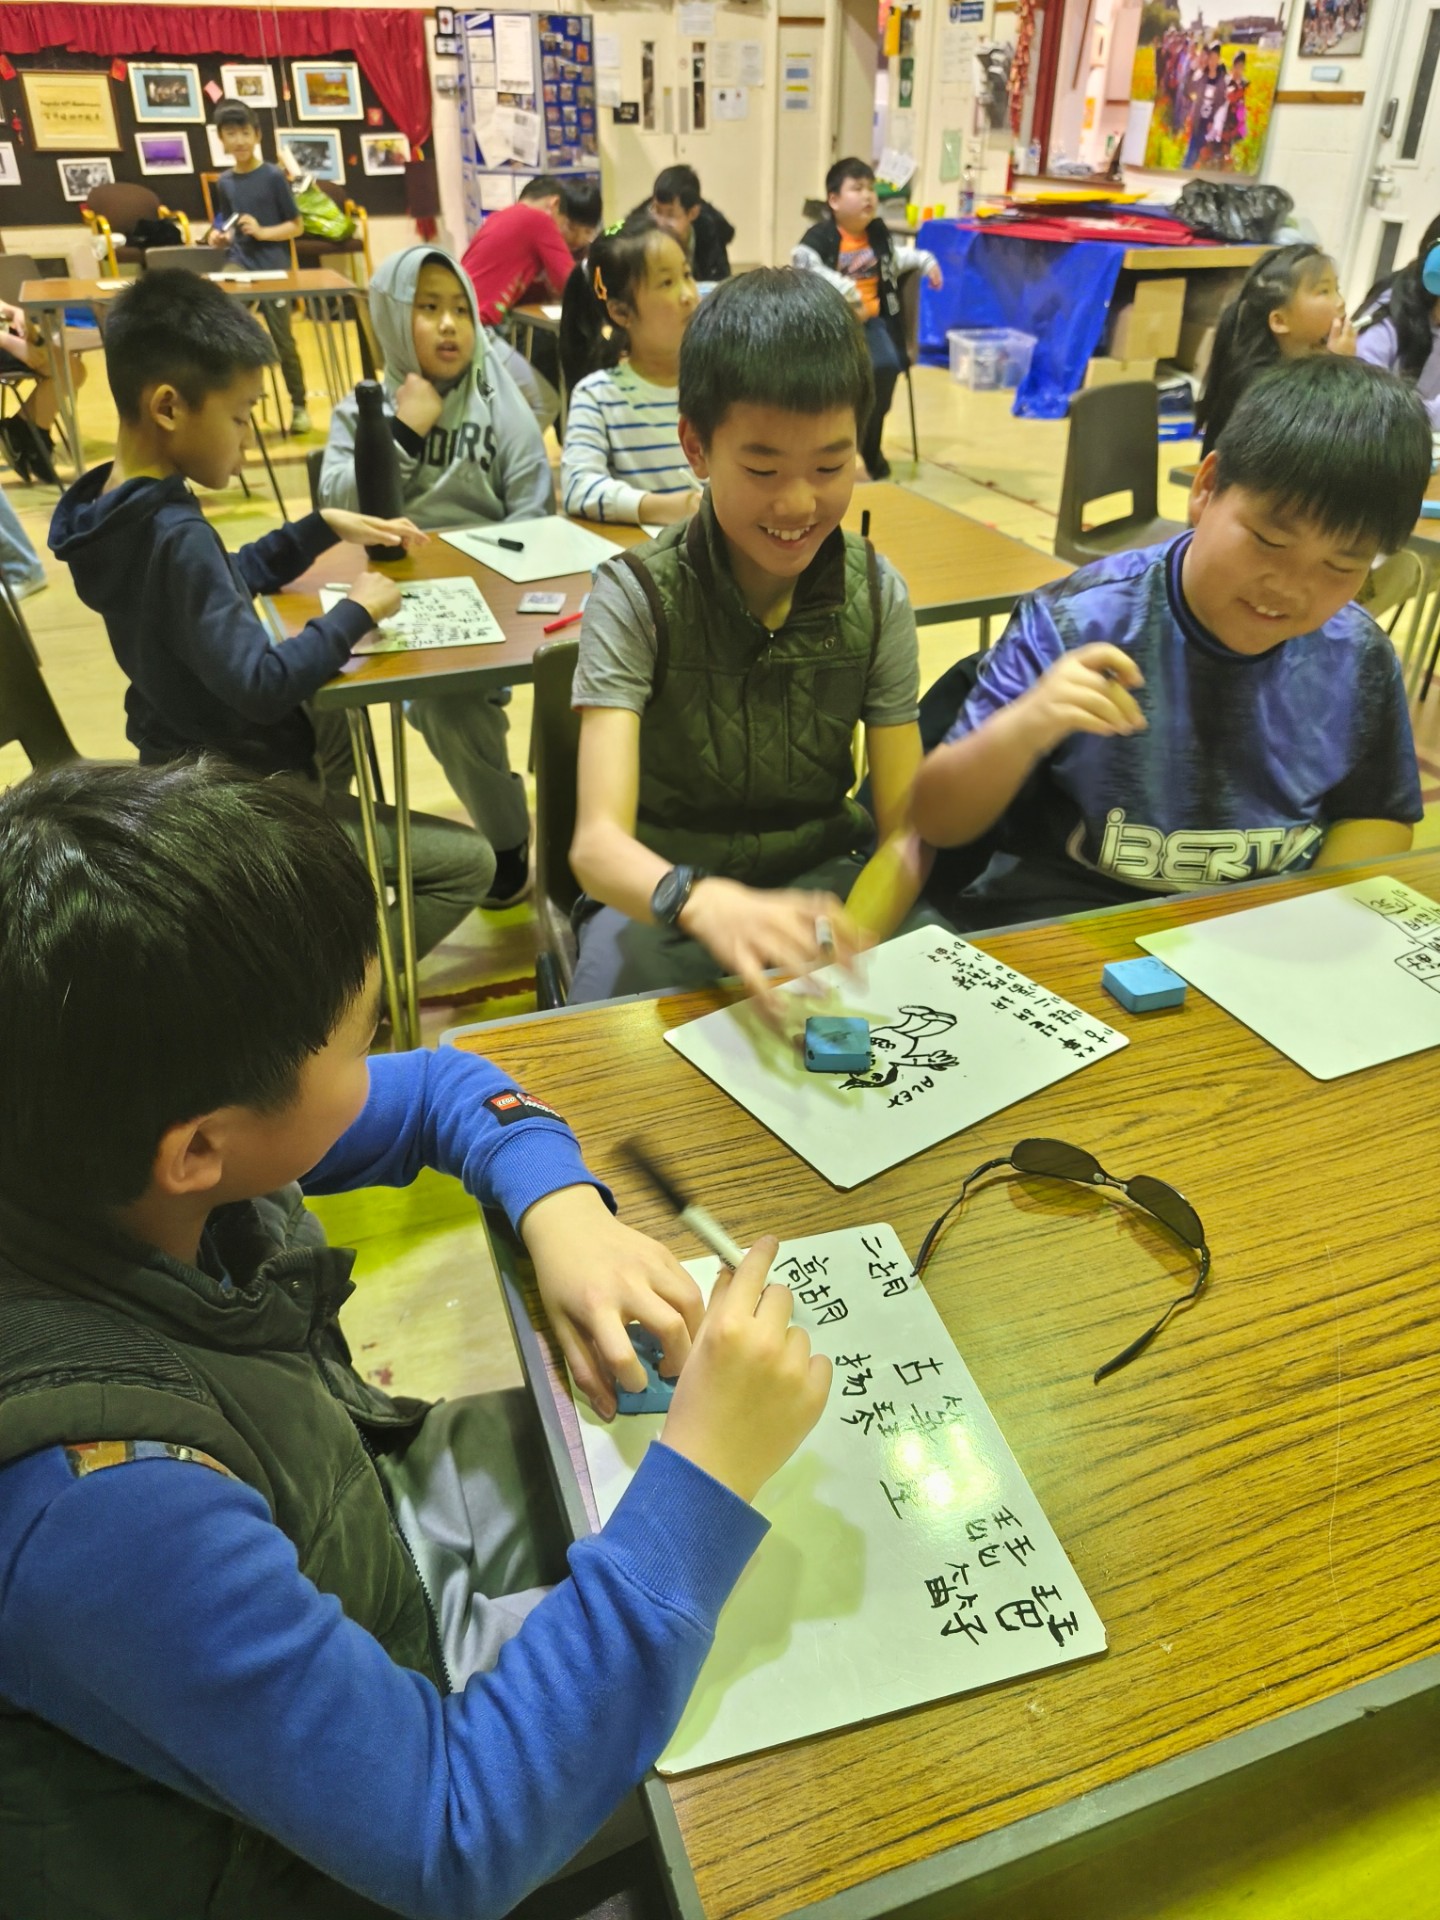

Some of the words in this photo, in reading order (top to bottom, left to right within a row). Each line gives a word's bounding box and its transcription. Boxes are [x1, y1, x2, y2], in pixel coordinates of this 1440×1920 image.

[887, 1075, 934, 1108] ALEX
[773, 1254, 849, 1326] 高胡
[923, 1561, 988, 1646] 笛子
[860, 1235, 909, 1298] 二胡
[964, 1505, 1079, 1648] 琵琶
